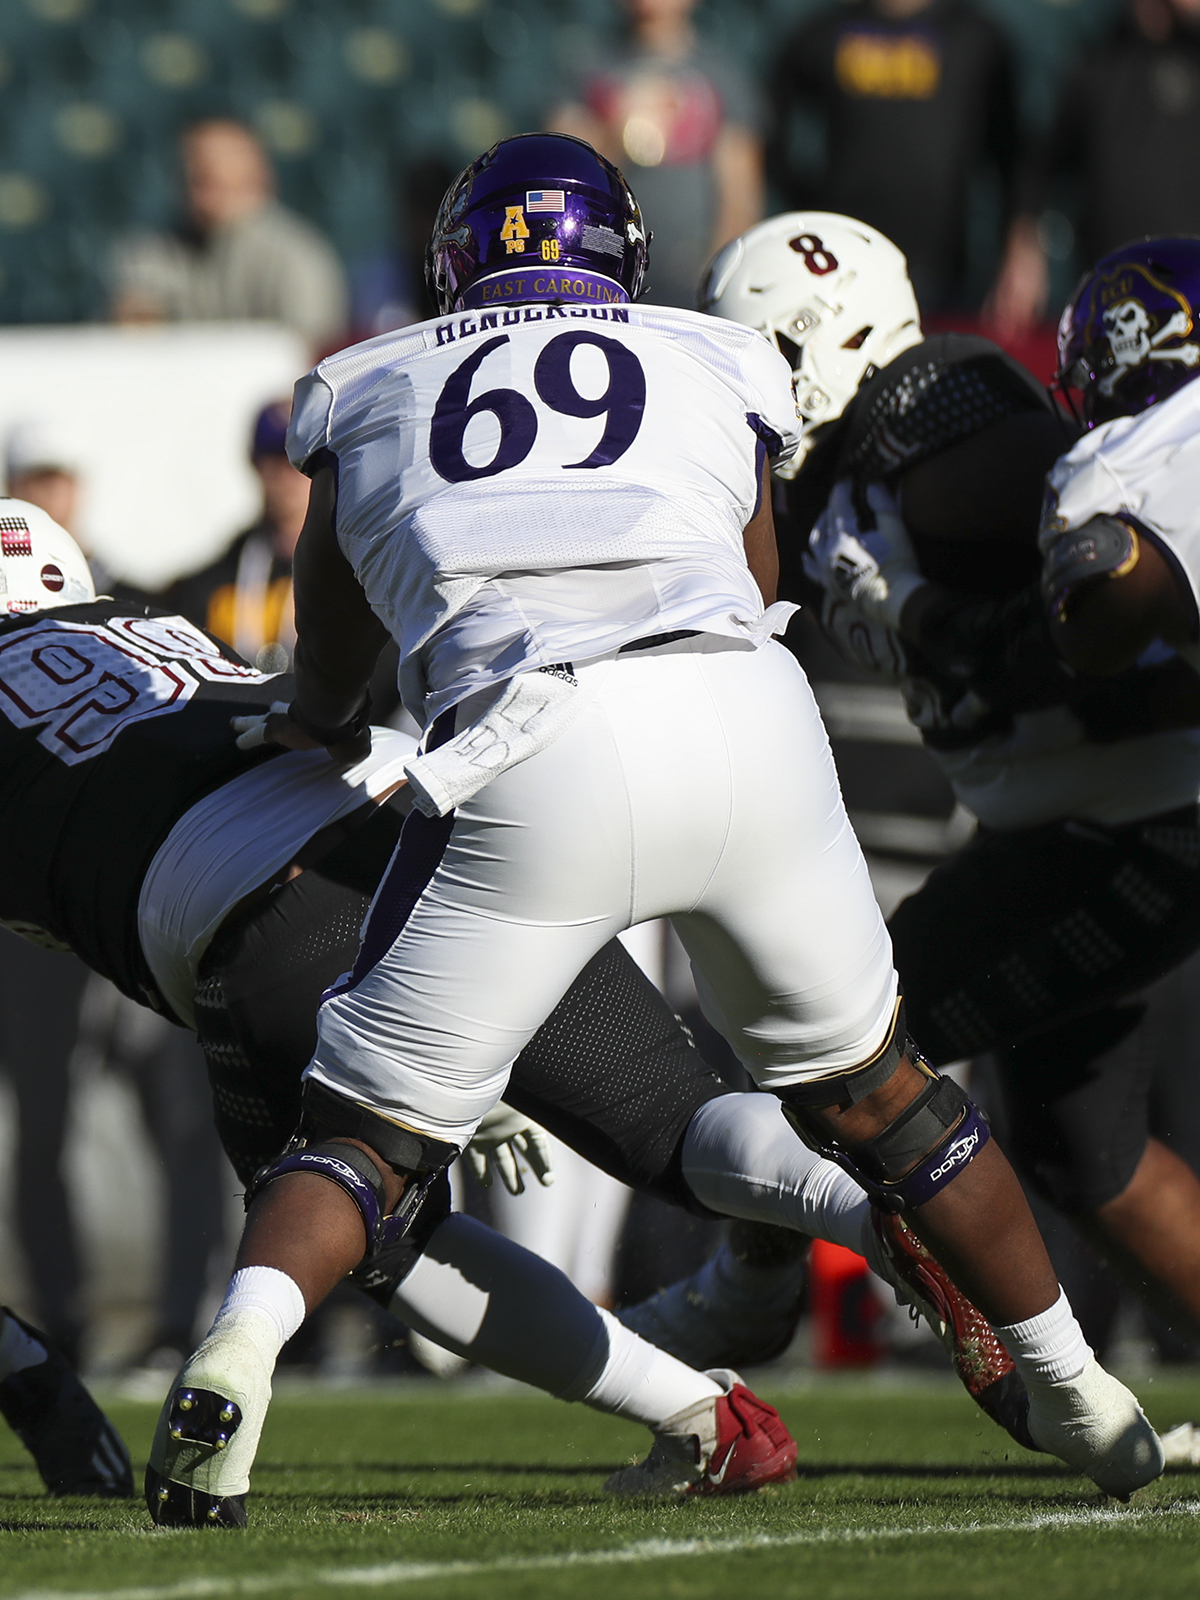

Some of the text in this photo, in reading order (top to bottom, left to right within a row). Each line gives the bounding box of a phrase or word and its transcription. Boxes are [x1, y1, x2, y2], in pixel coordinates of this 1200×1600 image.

[505, 239, 525, 254] P6
[541, 239, 560, 261] 69
[789, 234, 839, 275] 8
[482, 277, 621, 304] EAST CAROLINA
[429, 330, 646, 483] 69
[539, 665, 578, 687] adidas
[930, 1128, 979, 1181] DONJOY
[300, 1155, 366, 1188] DONJOY
